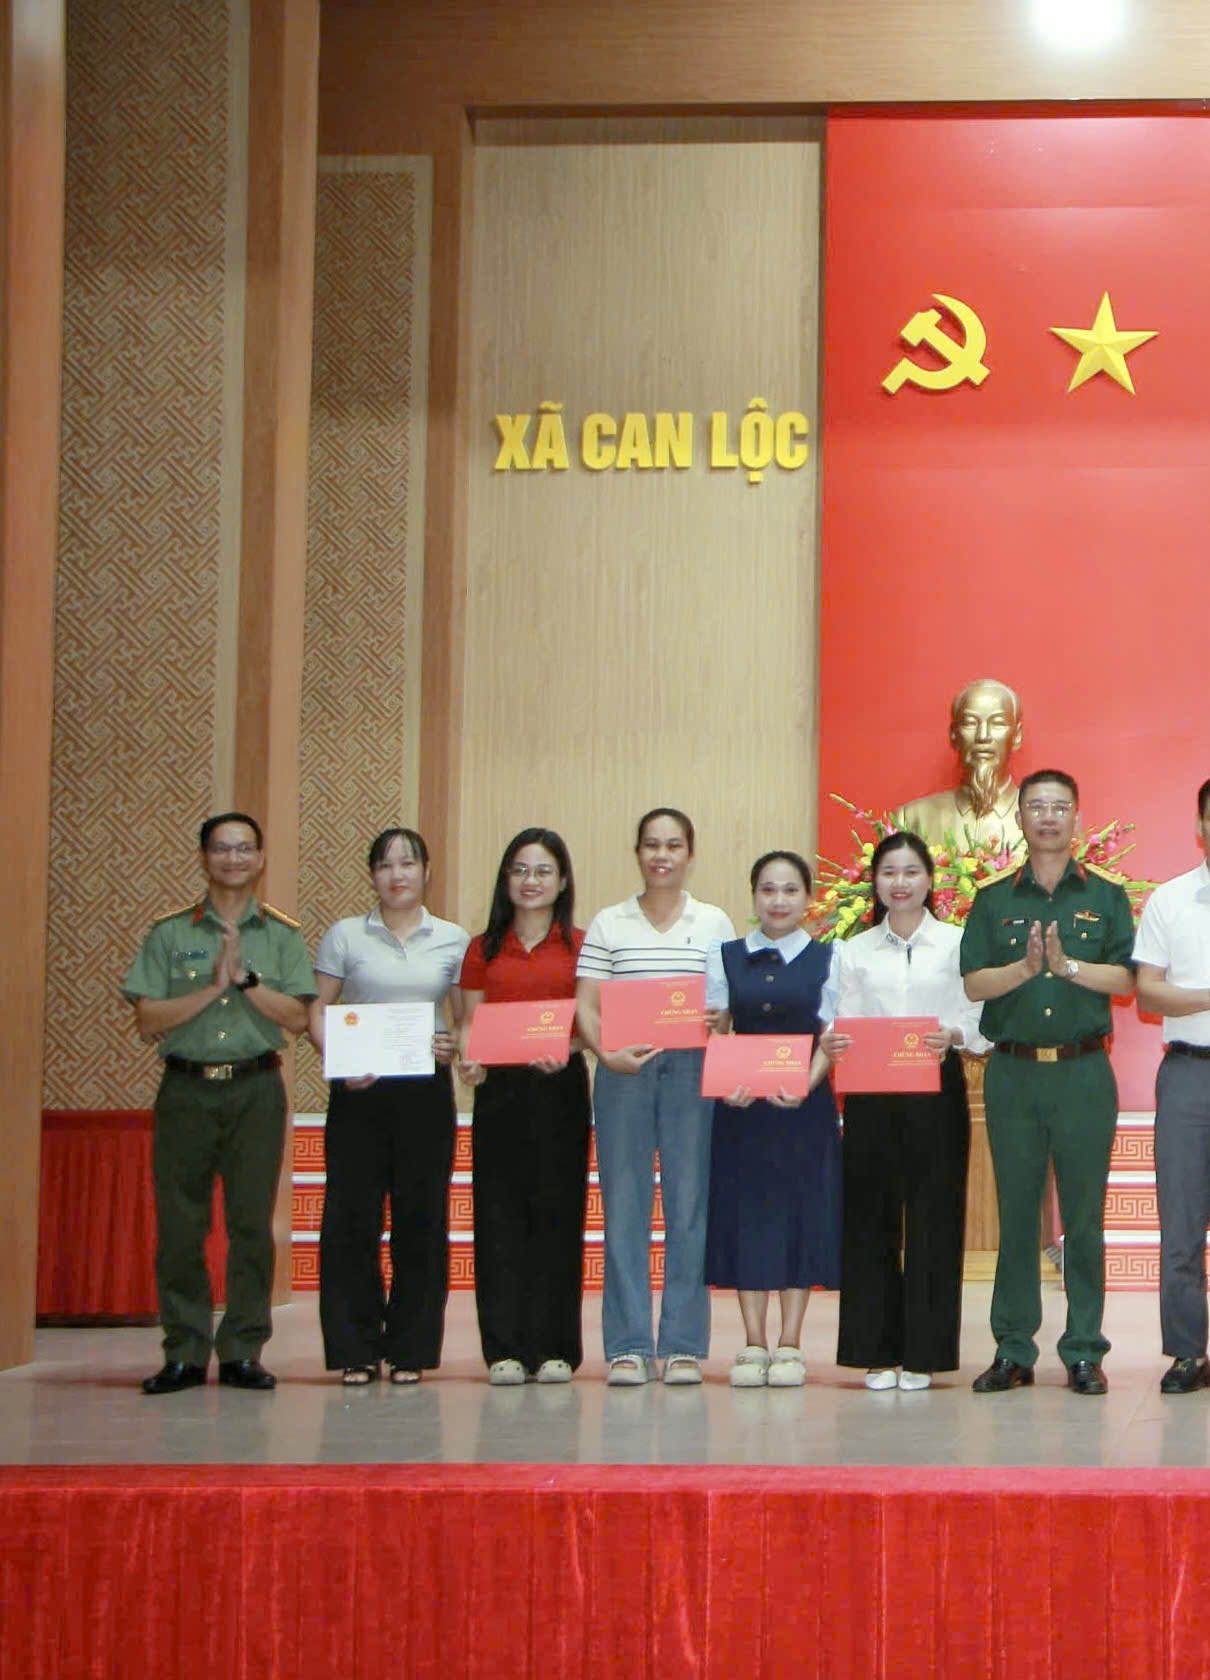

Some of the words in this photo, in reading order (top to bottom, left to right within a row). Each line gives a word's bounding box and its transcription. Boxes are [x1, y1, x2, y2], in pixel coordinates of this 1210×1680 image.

[494, 400, 570, 470] XÃ
[581, 411, 693, 470] CAN
[711, 396, 809, 484] LỘC
